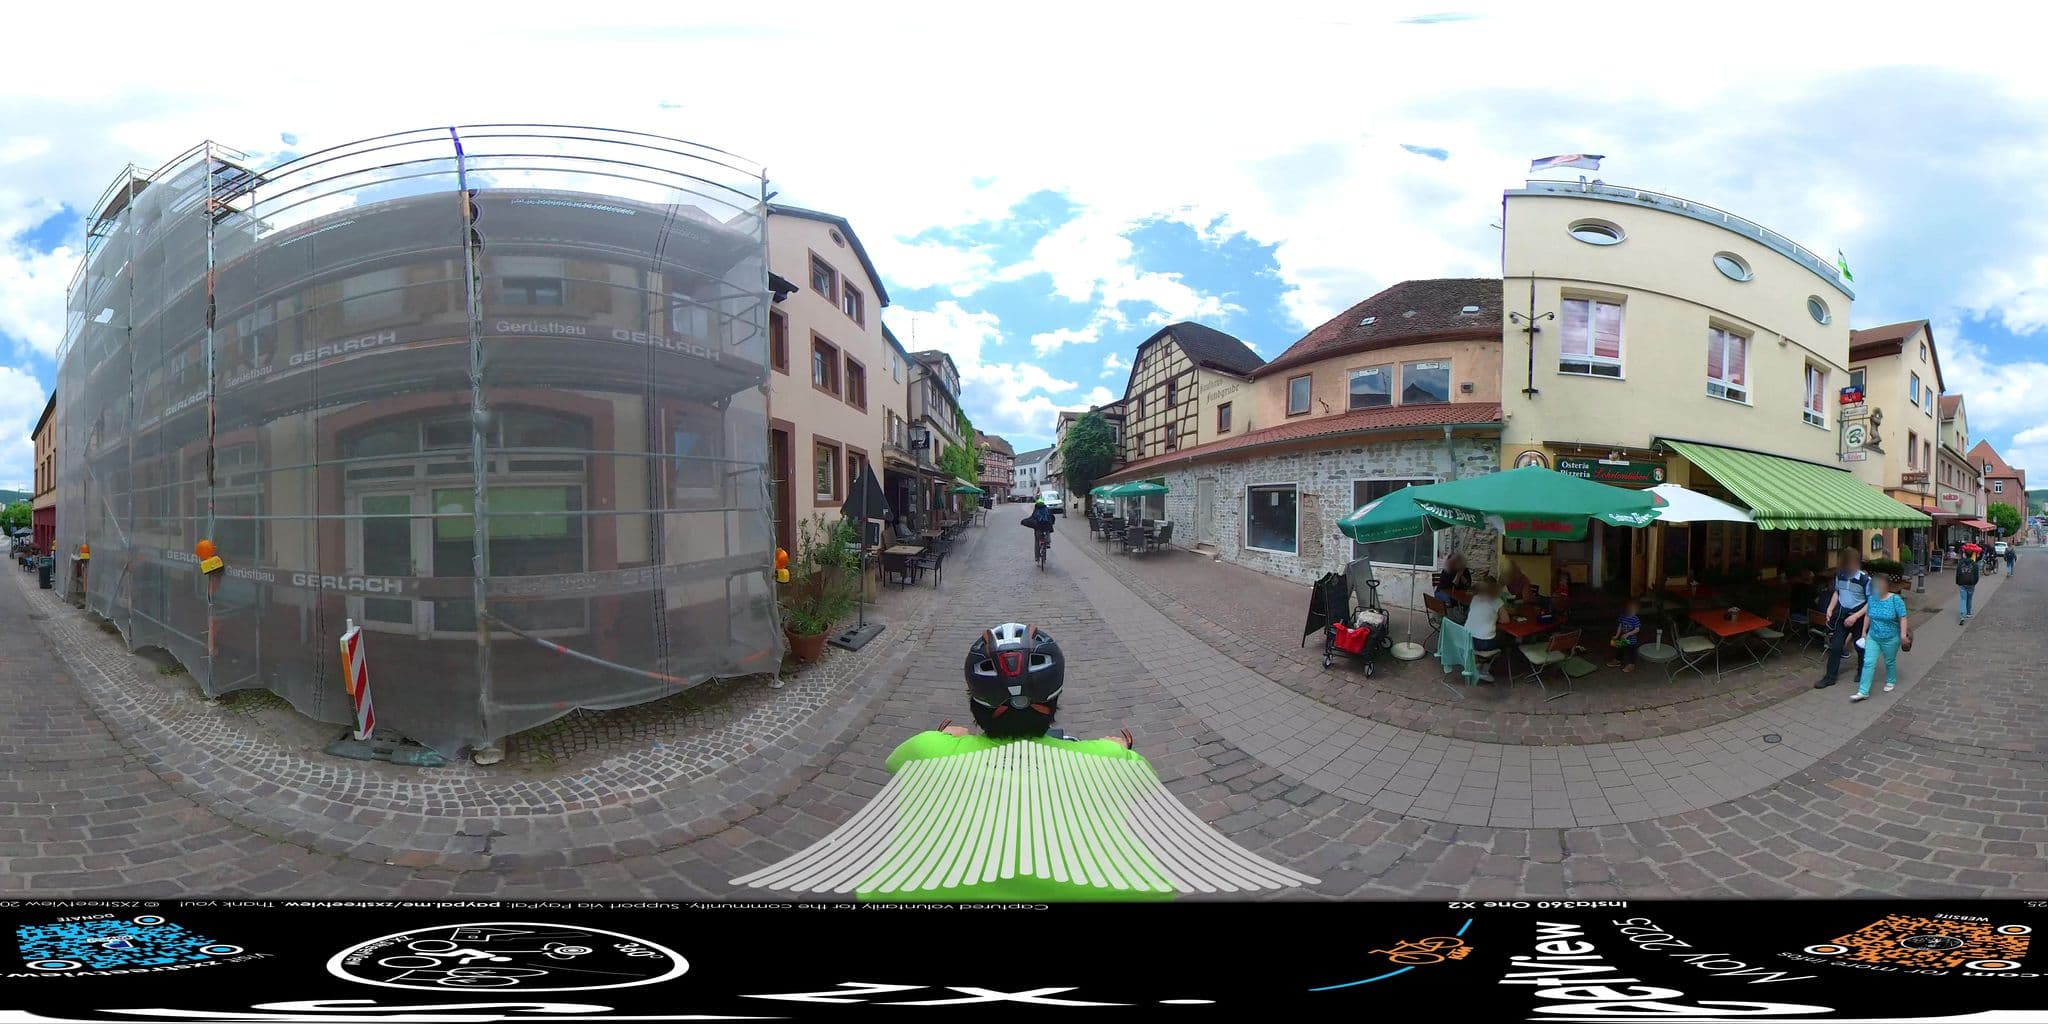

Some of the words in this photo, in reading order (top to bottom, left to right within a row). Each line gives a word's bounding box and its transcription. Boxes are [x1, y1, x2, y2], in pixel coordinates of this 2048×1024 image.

[224, 365, 273, 389] Gerüstbau
[289, 331, 397, 366] GERLACH
[496, 320, 587, 336] Gerüstbau
[612, 328, 720, 361] GERLACH
[1561, 461, 1589, 469] Osteria
[167, 550, 201, 564] GERLA
[226, 565, 275, 583] Gerüstbau
[292, 572, 403, 593] GERLACH
